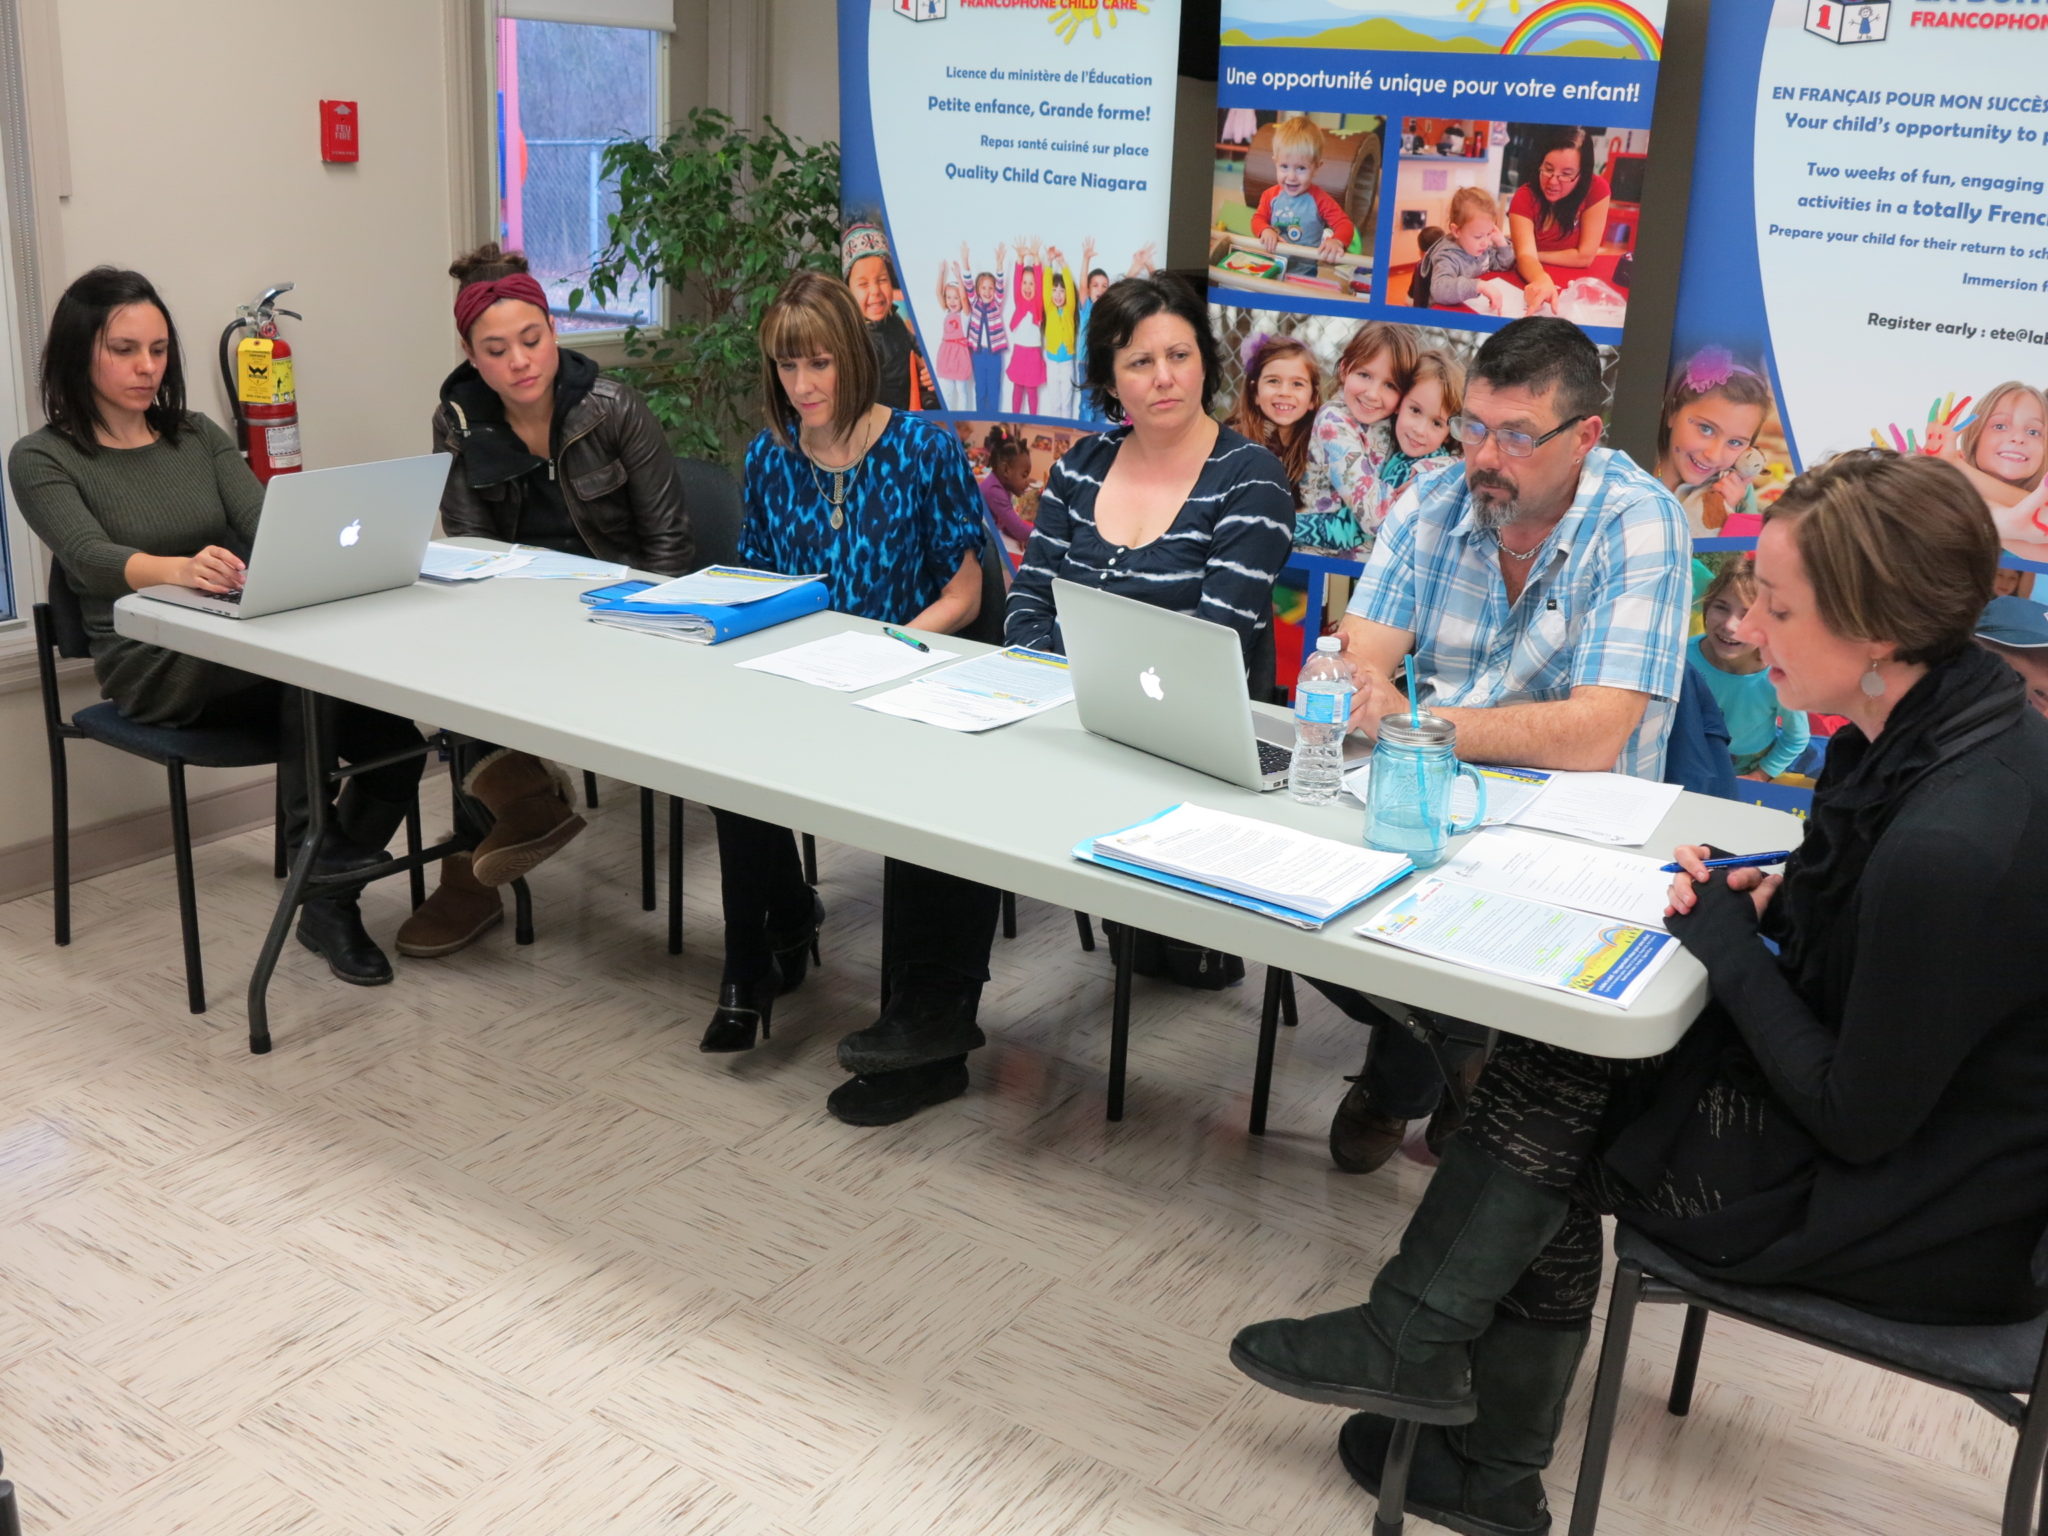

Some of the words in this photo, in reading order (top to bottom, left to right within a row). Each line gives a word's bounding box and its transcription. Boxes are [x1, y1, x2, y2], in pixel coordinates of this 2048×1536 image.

[1060, 0, 1098, 9] CHILD
[1103, 0, 1137, 9] CARE
[947, 66, 986, 79] Licence
[990, 68, 1004, 79] du
[1008, 69, 1061, 82] ministère
[1064, 70, 1078, 82] de
[1227, 67, 1257, 85] Une
[1262, 70, 1373, 90] opportunité
[1380, 74, 1447, 96] unique
[1453, 80, 1498, 98] pour
[1504, 79, 1556, 97] votre
[1563, 81, 1640, 102] enfant!
[929, 96, 970, 112] Petite
[975, 99, 1034, 117] enfance,
[1039, 101, 1093, 118] Grande
[1098, 104, 1150, 121] forme!
[1773, 87, 1795, 100] EN
[1799, 88, 1881, 106] FRANÇAIS
[1886, 92, 1935, 107] POUR
[1940, 95, 1982, 109] MON
[336, 125, 351, 133] FEU
[1786, 112, 1828, 129] Your
[1896, 123, 2012, 143] opportunity
[2017, 127, 2037, 142] to
[981, 135, 1014, 149] Repas
[1018, 139, 1048, 150] santé
[1051, 140, 1089, 152] cuisiné
[1093, 145, 1110, 154] sur
[1114, 143, 1149, 156] place
[945, 163, 998, 183] Quality
[1003, 167, 1039, 183] Child
[1043, 170, 1077, 186] Care
[1081, 172, 1147, 192] Niagara
[1808, 162, 1839, 177] Two
[1845, 167, 1895, 181] weeks
[1901, 169, 1918, 182] of
[1922, 169, 1955, 187] fun,
[1961, 177, 2044, 195] engaging
[1798, 196, 1871, 211] activities
[1876, 199, 1892, 213] in
[1897, 204, 1908, 214] a
[1913, 200, 1982, 223] totally
[1769, 224, 1823, 239] Prepare
[1827, 232, 1858, 242] your
[1862, 232, 1896, 245] child
[1900, 235, 1920, 247] for
[1924, 237, 1957, 250] their
[1961, 243, 2005, 255] return
[2010, 246, 2024, 257] to
[1963, 273, 2037, 291] Immersion
[1868, 313, 1931, 331] Register
[1936, 323, 1977, 339] early
